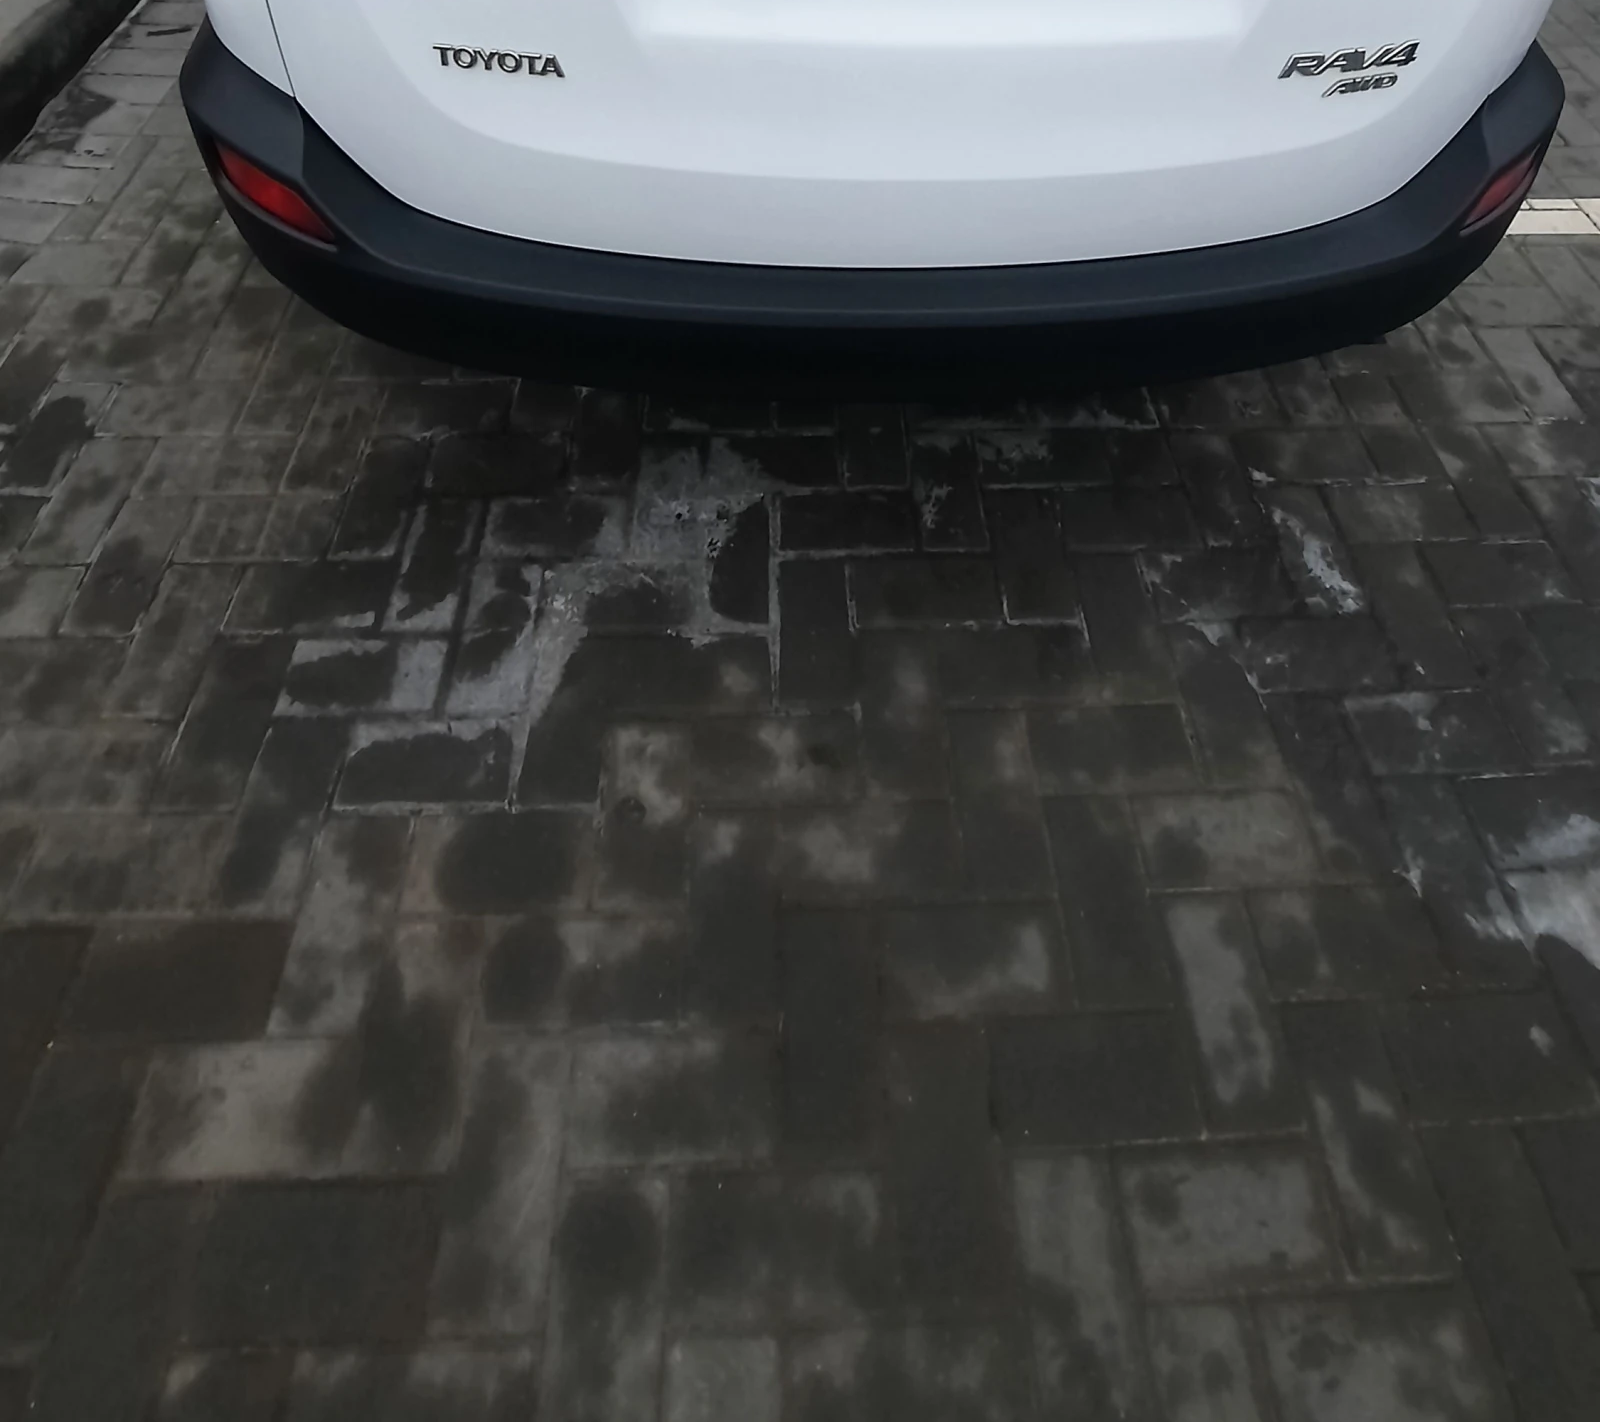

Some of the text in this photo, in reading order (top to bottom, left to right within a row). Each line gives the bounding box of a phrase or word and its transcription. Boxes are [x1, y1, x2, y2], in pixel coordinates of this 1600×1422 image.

[432, 43, 566, 78] TOYOTA
[1277, 39, 1420, 79] RAV4
[1321, 72, 1398, 98] AWD
